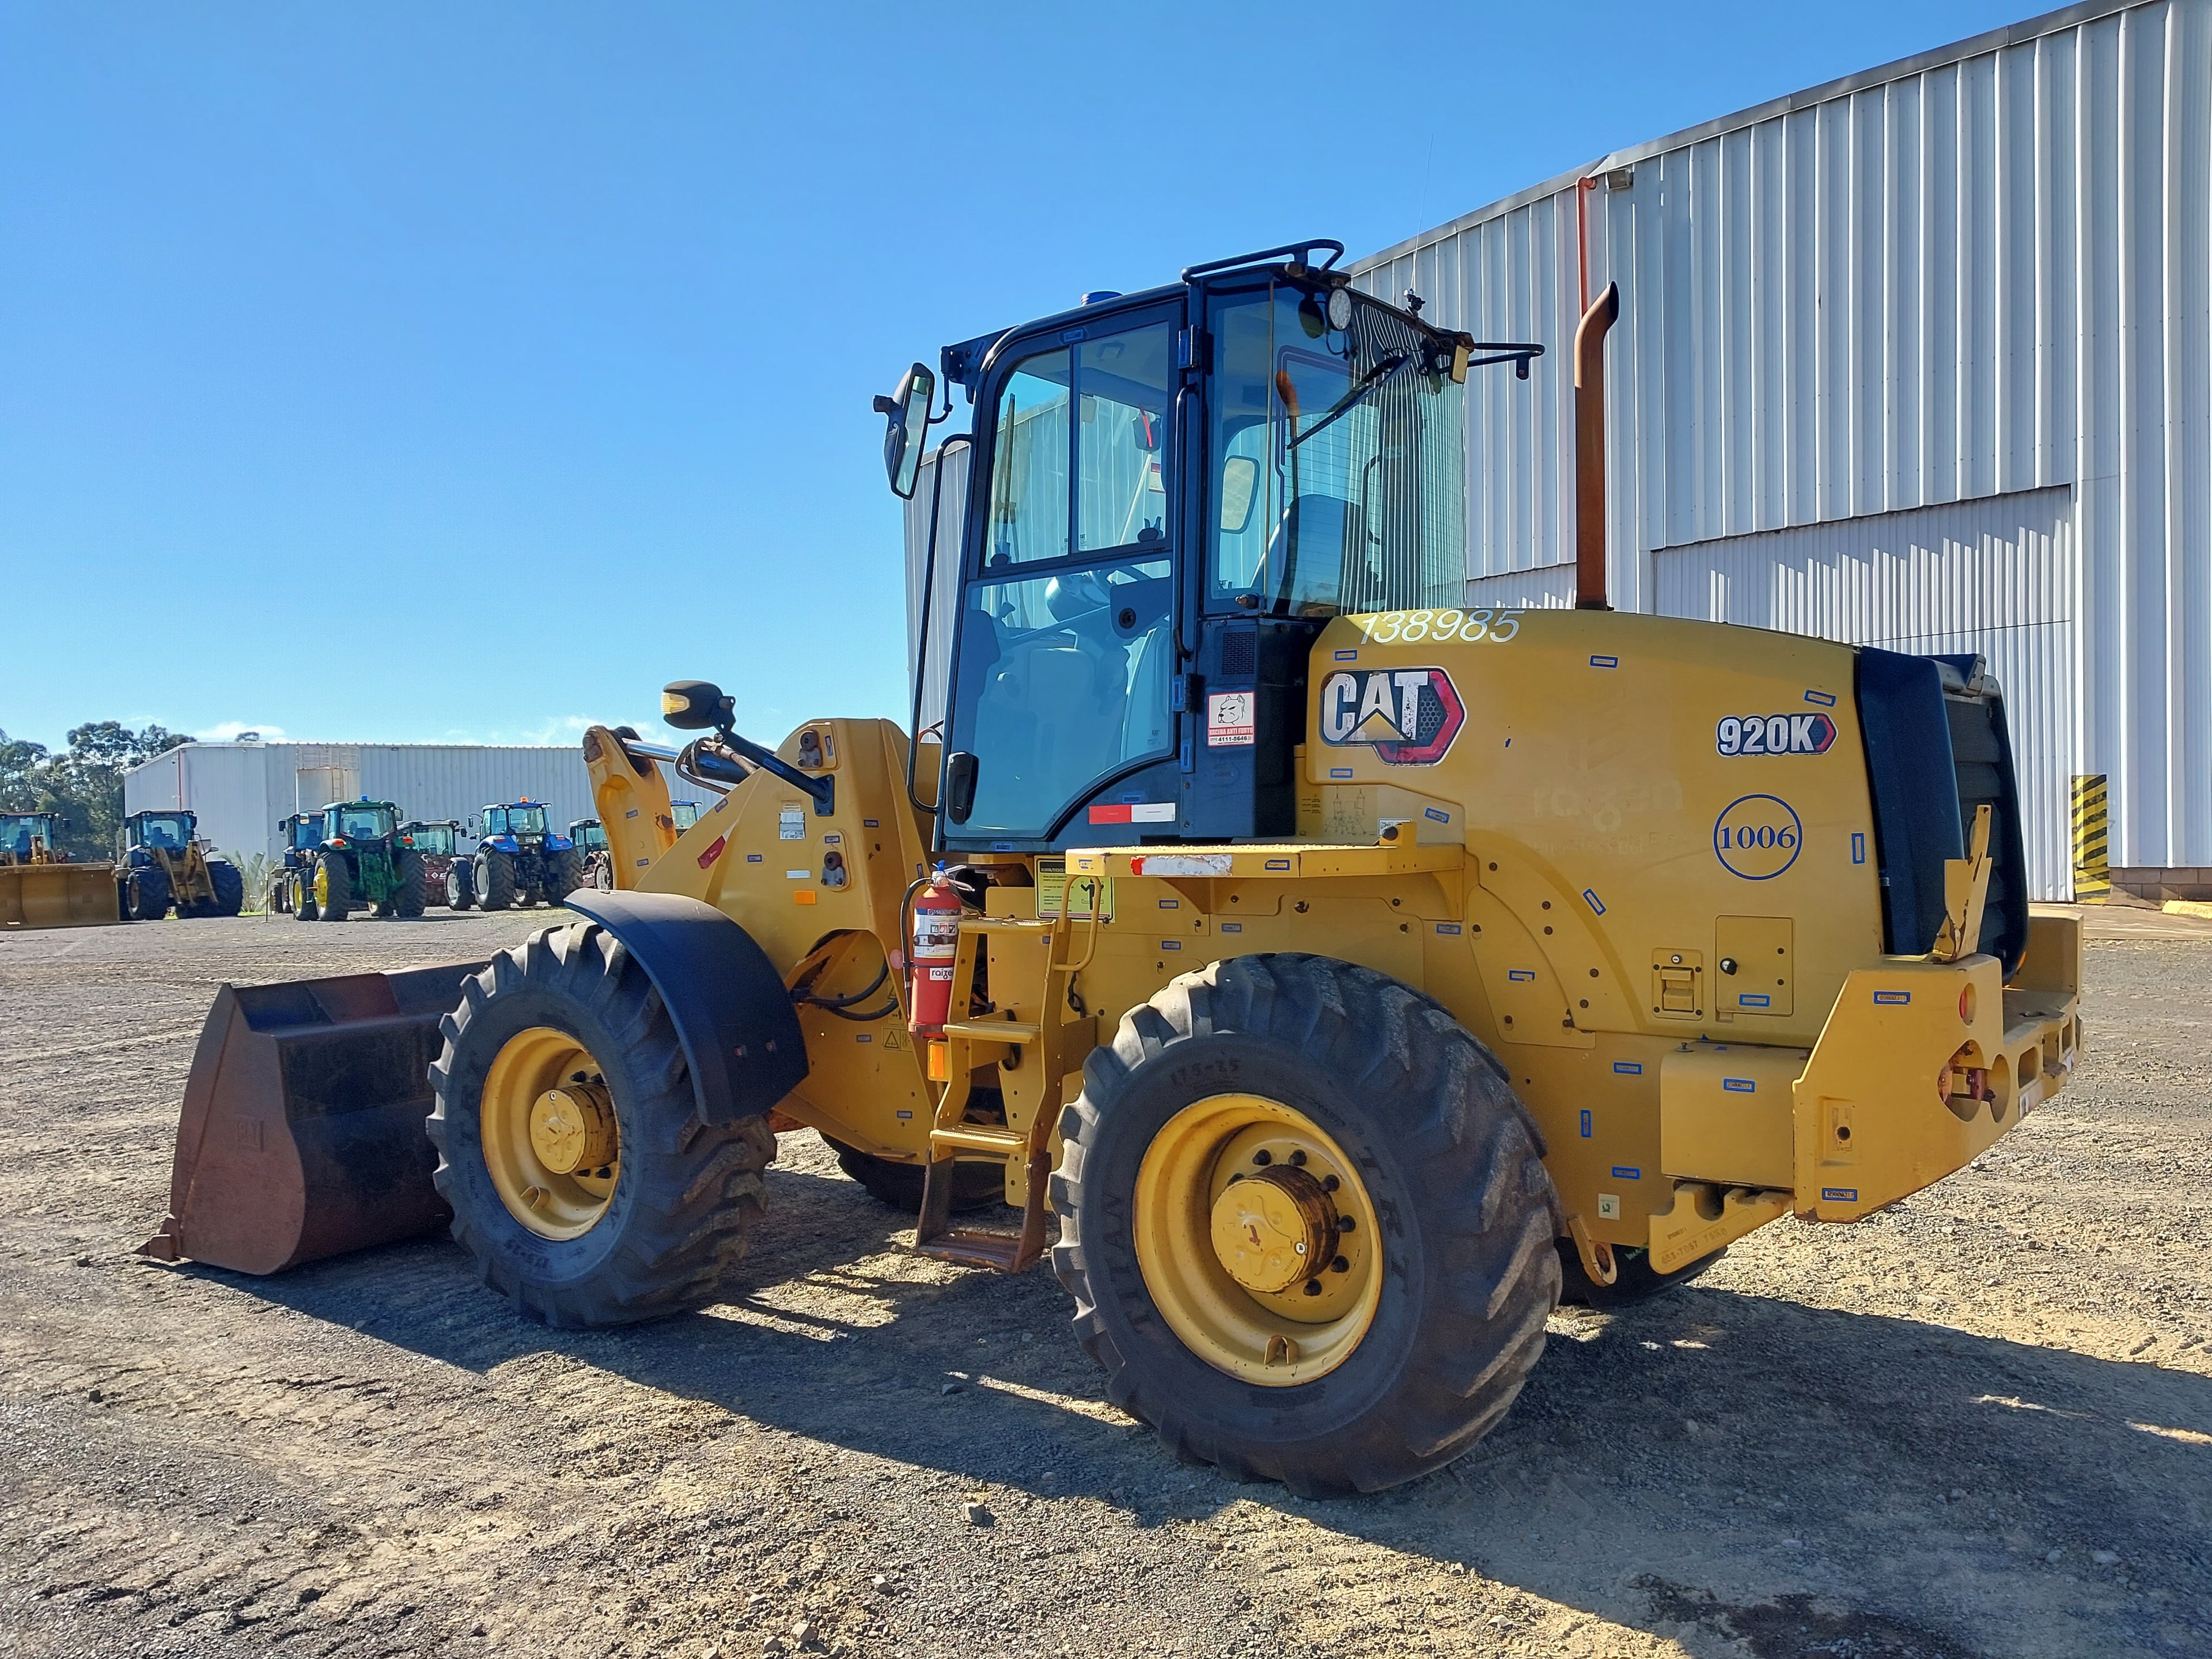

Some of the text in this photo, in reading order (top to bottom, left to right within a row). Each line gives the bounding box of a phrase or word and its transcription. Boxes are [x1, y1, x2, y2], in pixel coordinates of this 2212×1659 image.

[1360, 609, 1526, 645] 138985
[1323, 671, 1429, 741] CAT
[1719, 715, 1816, 753] 920K
[1720, 825, 1796, 849] 1006
